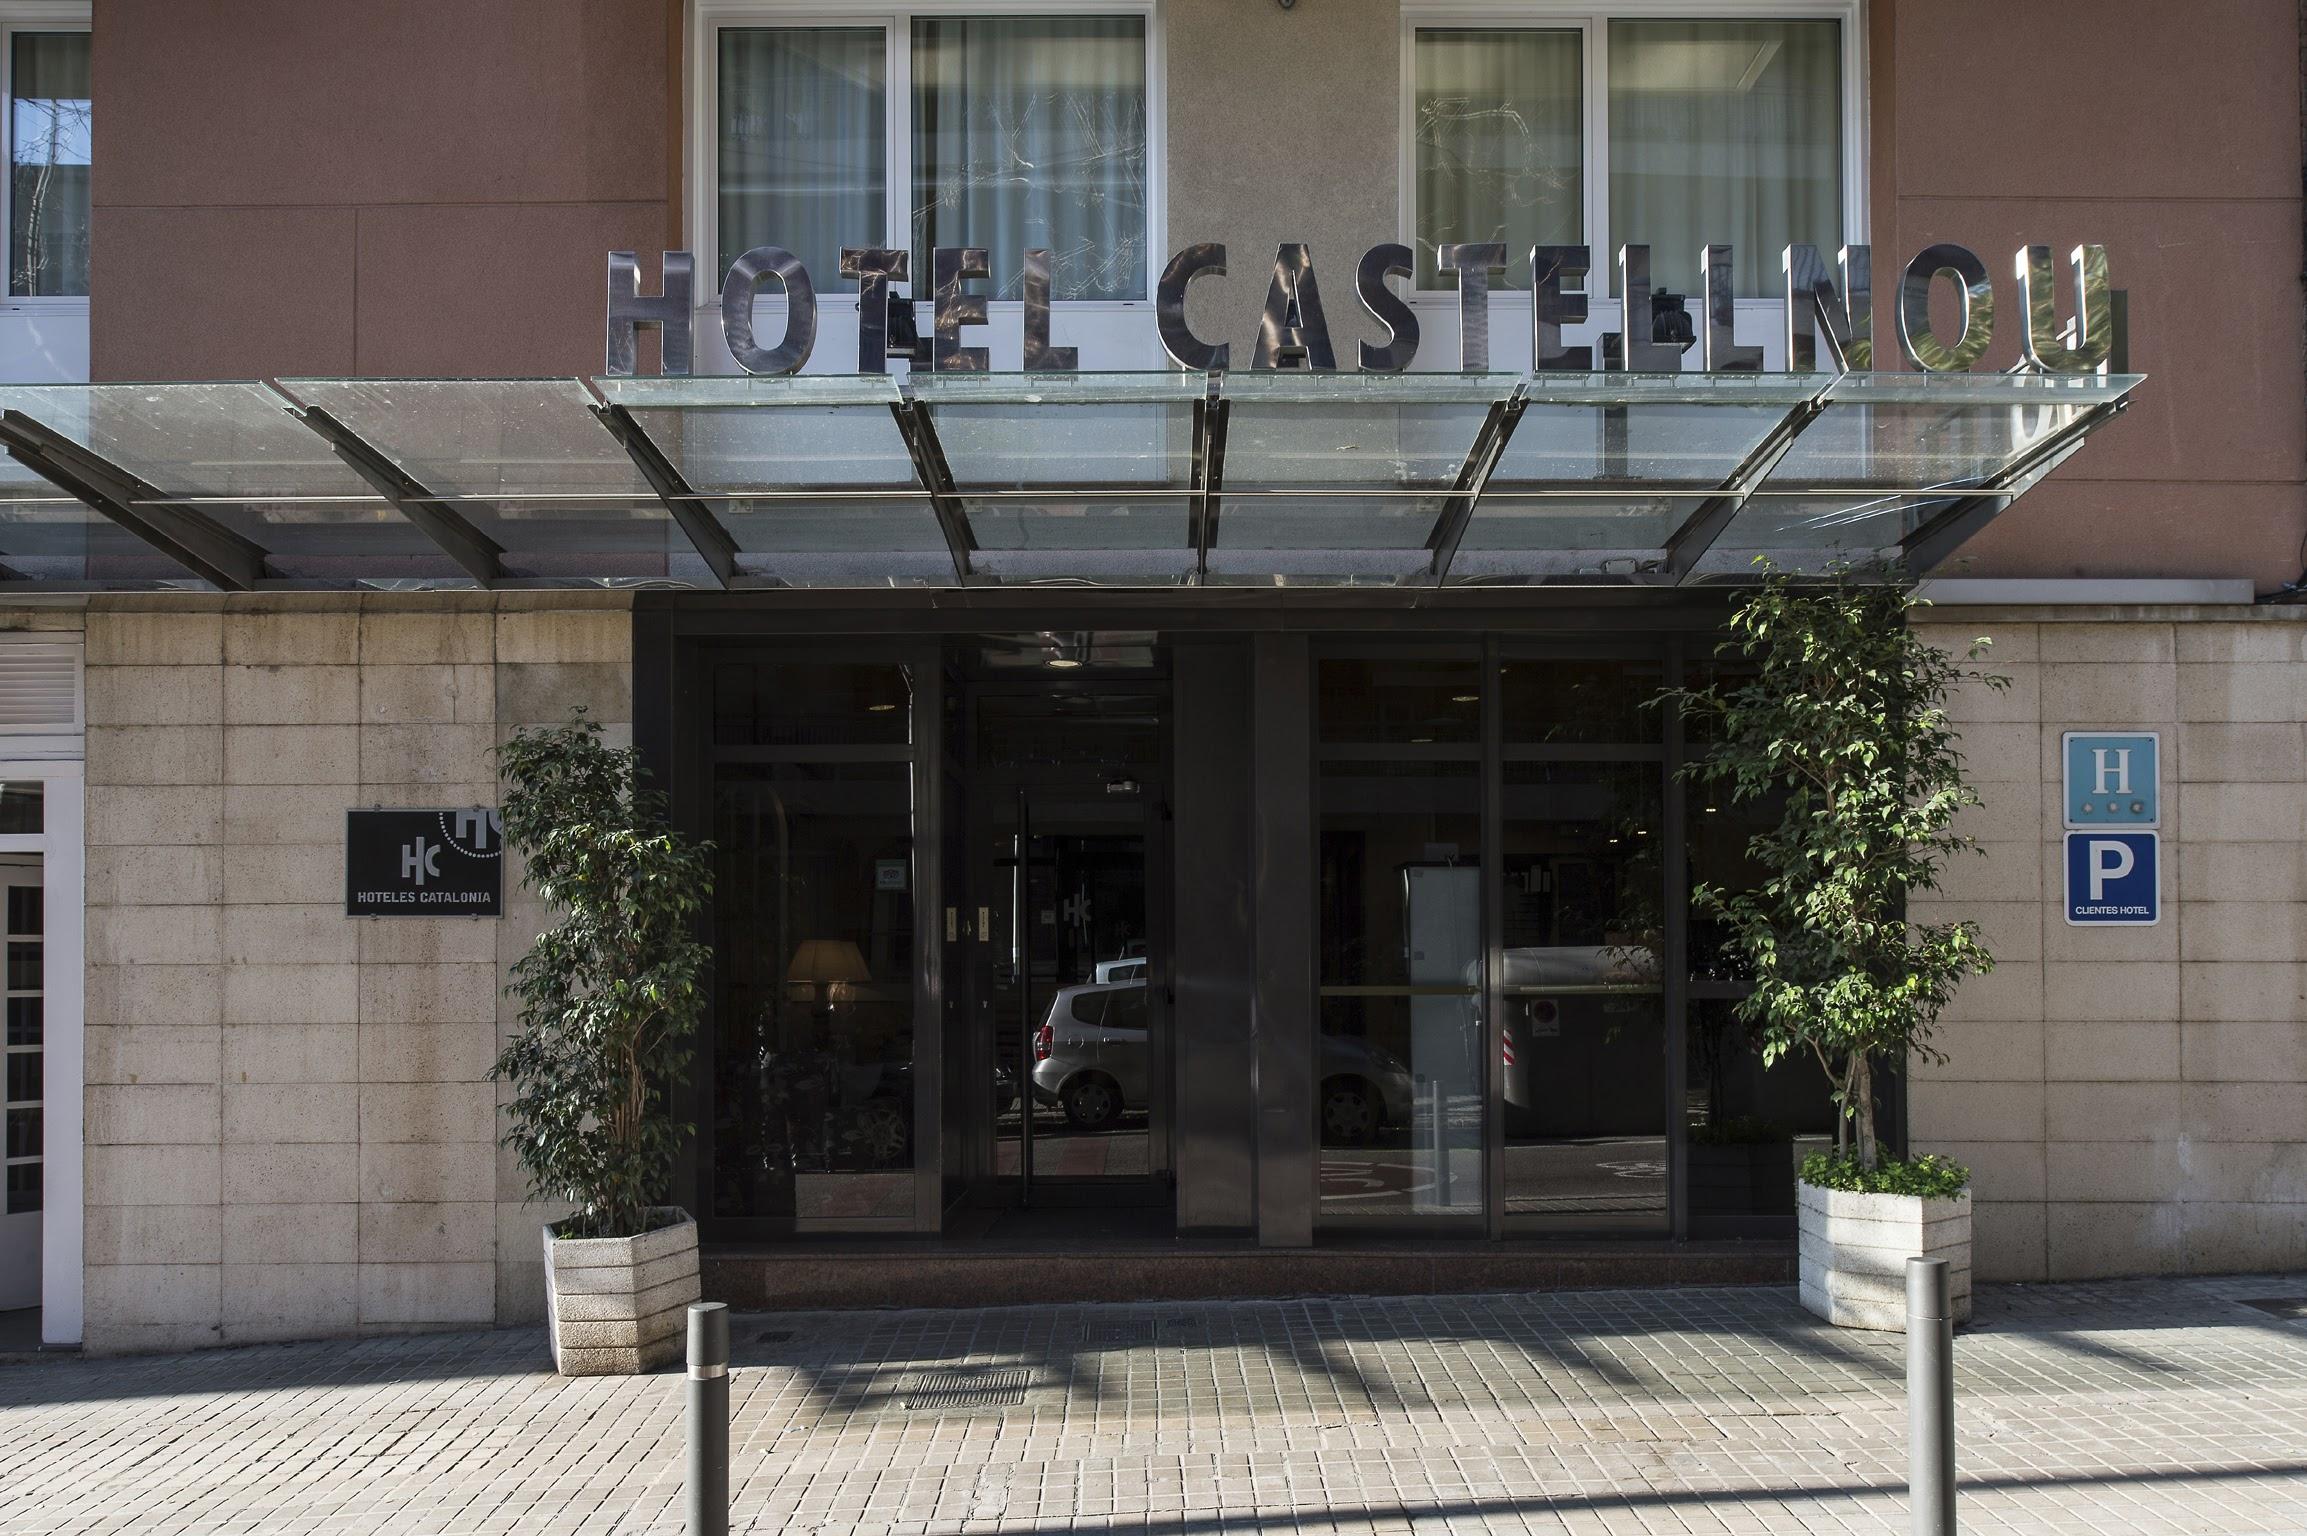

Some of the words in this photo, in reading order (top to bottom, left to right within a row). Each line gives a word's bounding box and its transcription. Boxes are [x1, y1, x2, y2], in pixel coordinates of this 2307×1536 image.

[606, 246, 1079, 375] HOTEL
[1156, 243, 2111, 374] CASTELLNOU
[2092, 749, 2133, 794] H
[402, 836, 441, 885] HC
[2089, 840, 2135, 900] P
[357, 891, 416, 903] HOTELES
[420, 891, 491, 903] CATALONIA
[2075, 906, 2119, 915] CLIENTES
[2119, 906, 2150, 915] HOTEL
